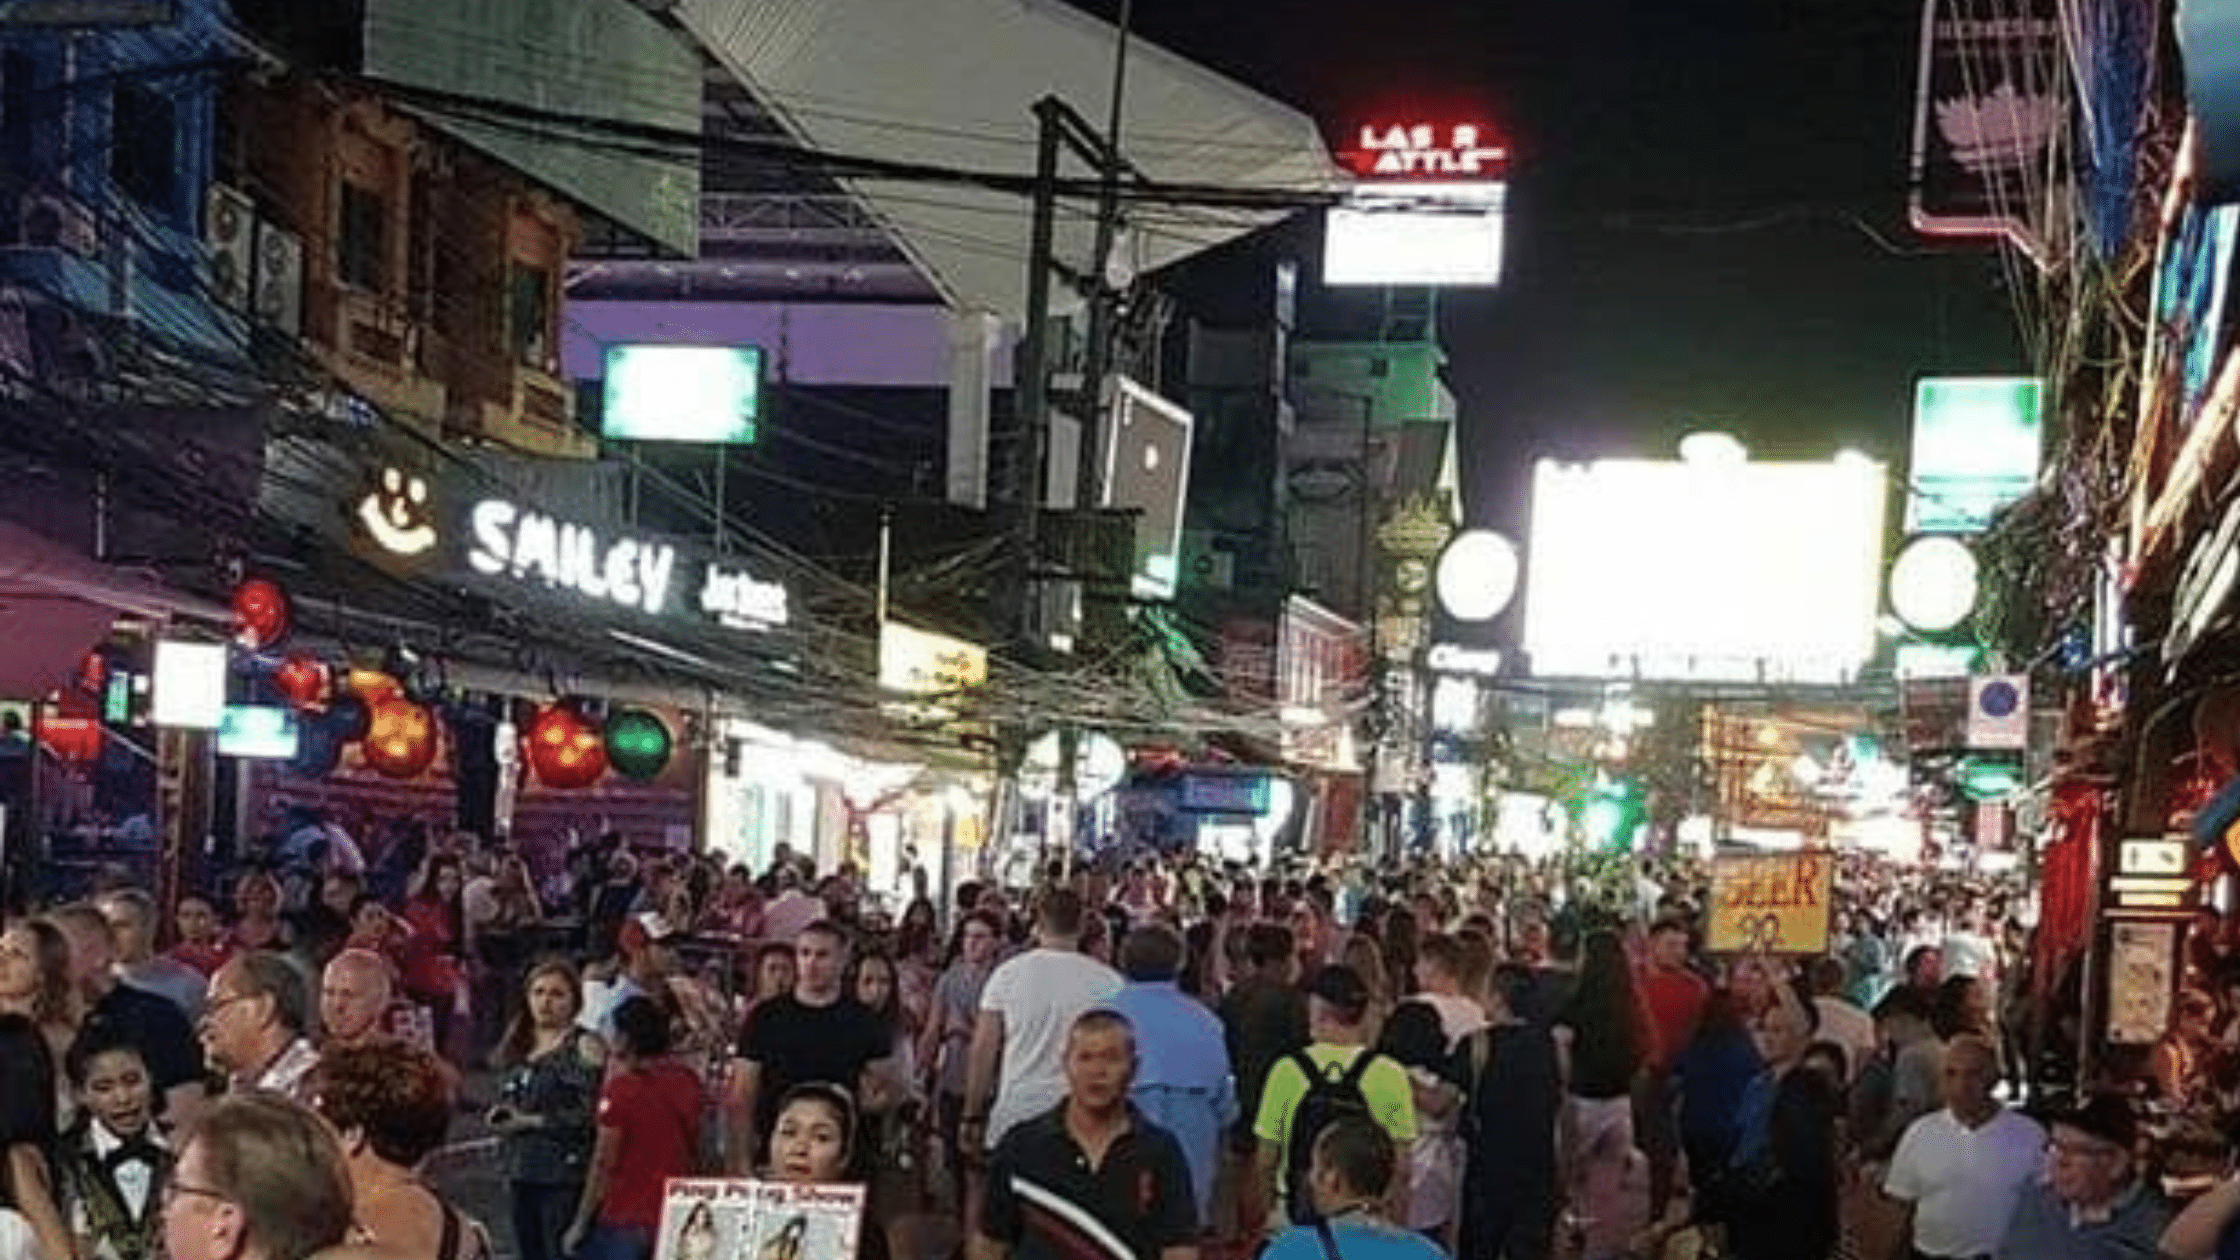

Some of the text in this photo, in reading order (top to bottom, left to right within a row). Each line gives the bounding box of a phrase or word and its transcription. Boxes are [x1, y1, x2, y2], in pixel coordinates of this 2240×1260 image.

[469, 500, 674, 613] SMILEY
[670, 1184, 718, 1201] Ping
[793, 1186, 857, 1202] Show
